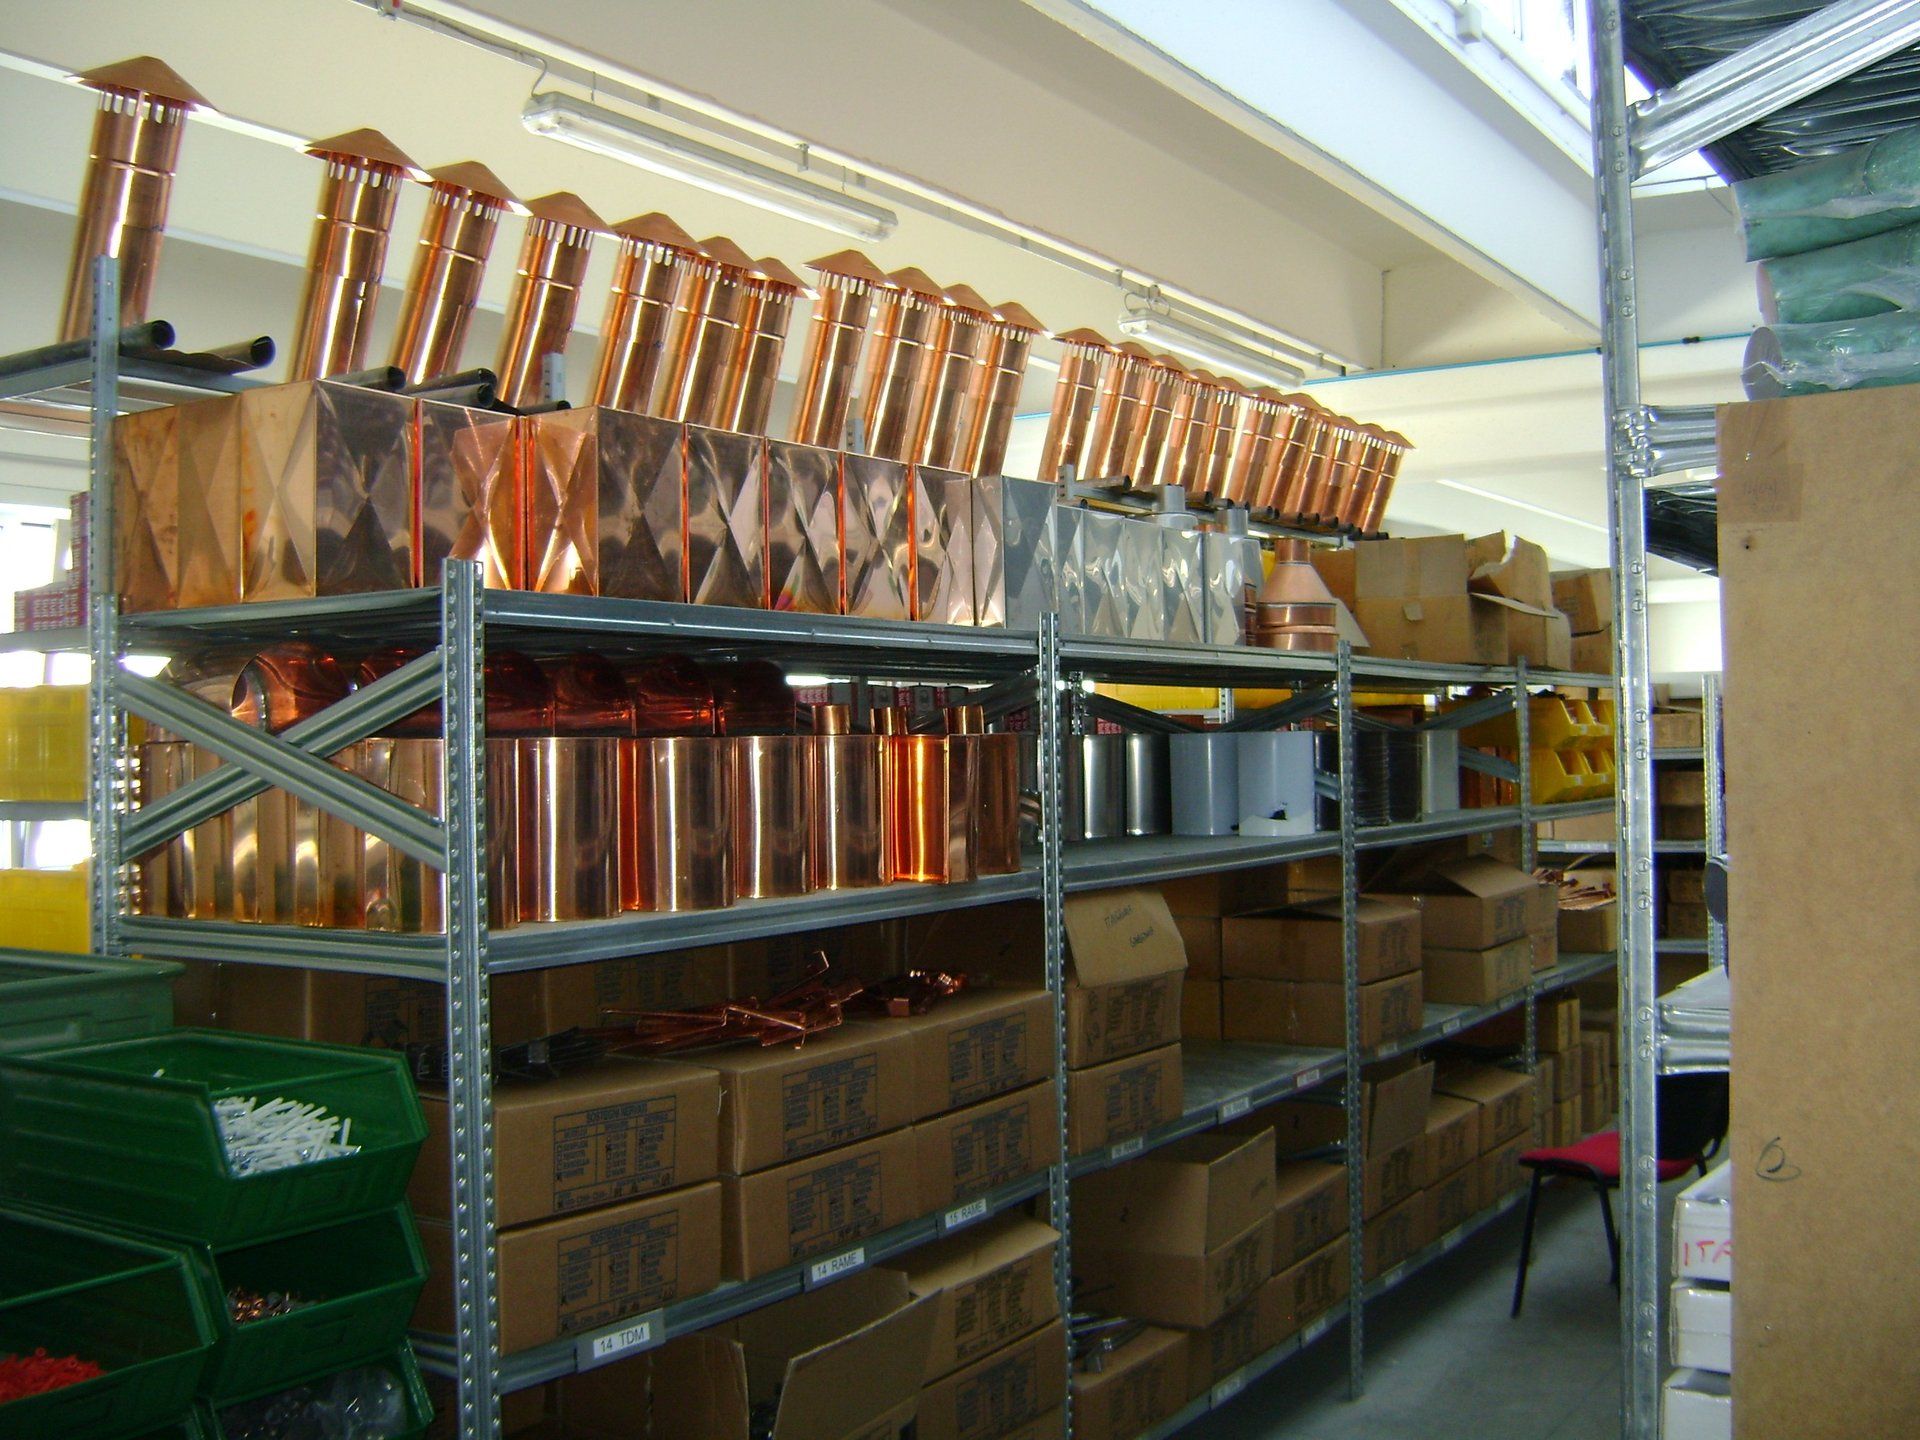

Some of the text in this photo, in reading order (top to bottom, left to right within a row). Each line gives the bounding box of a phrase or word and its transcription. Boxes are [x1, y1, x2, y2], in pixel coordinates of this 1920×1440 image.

[816, 1252, 858, 1278] 14 RAME
[600, 1327, 645, 1352] 14 TDM
